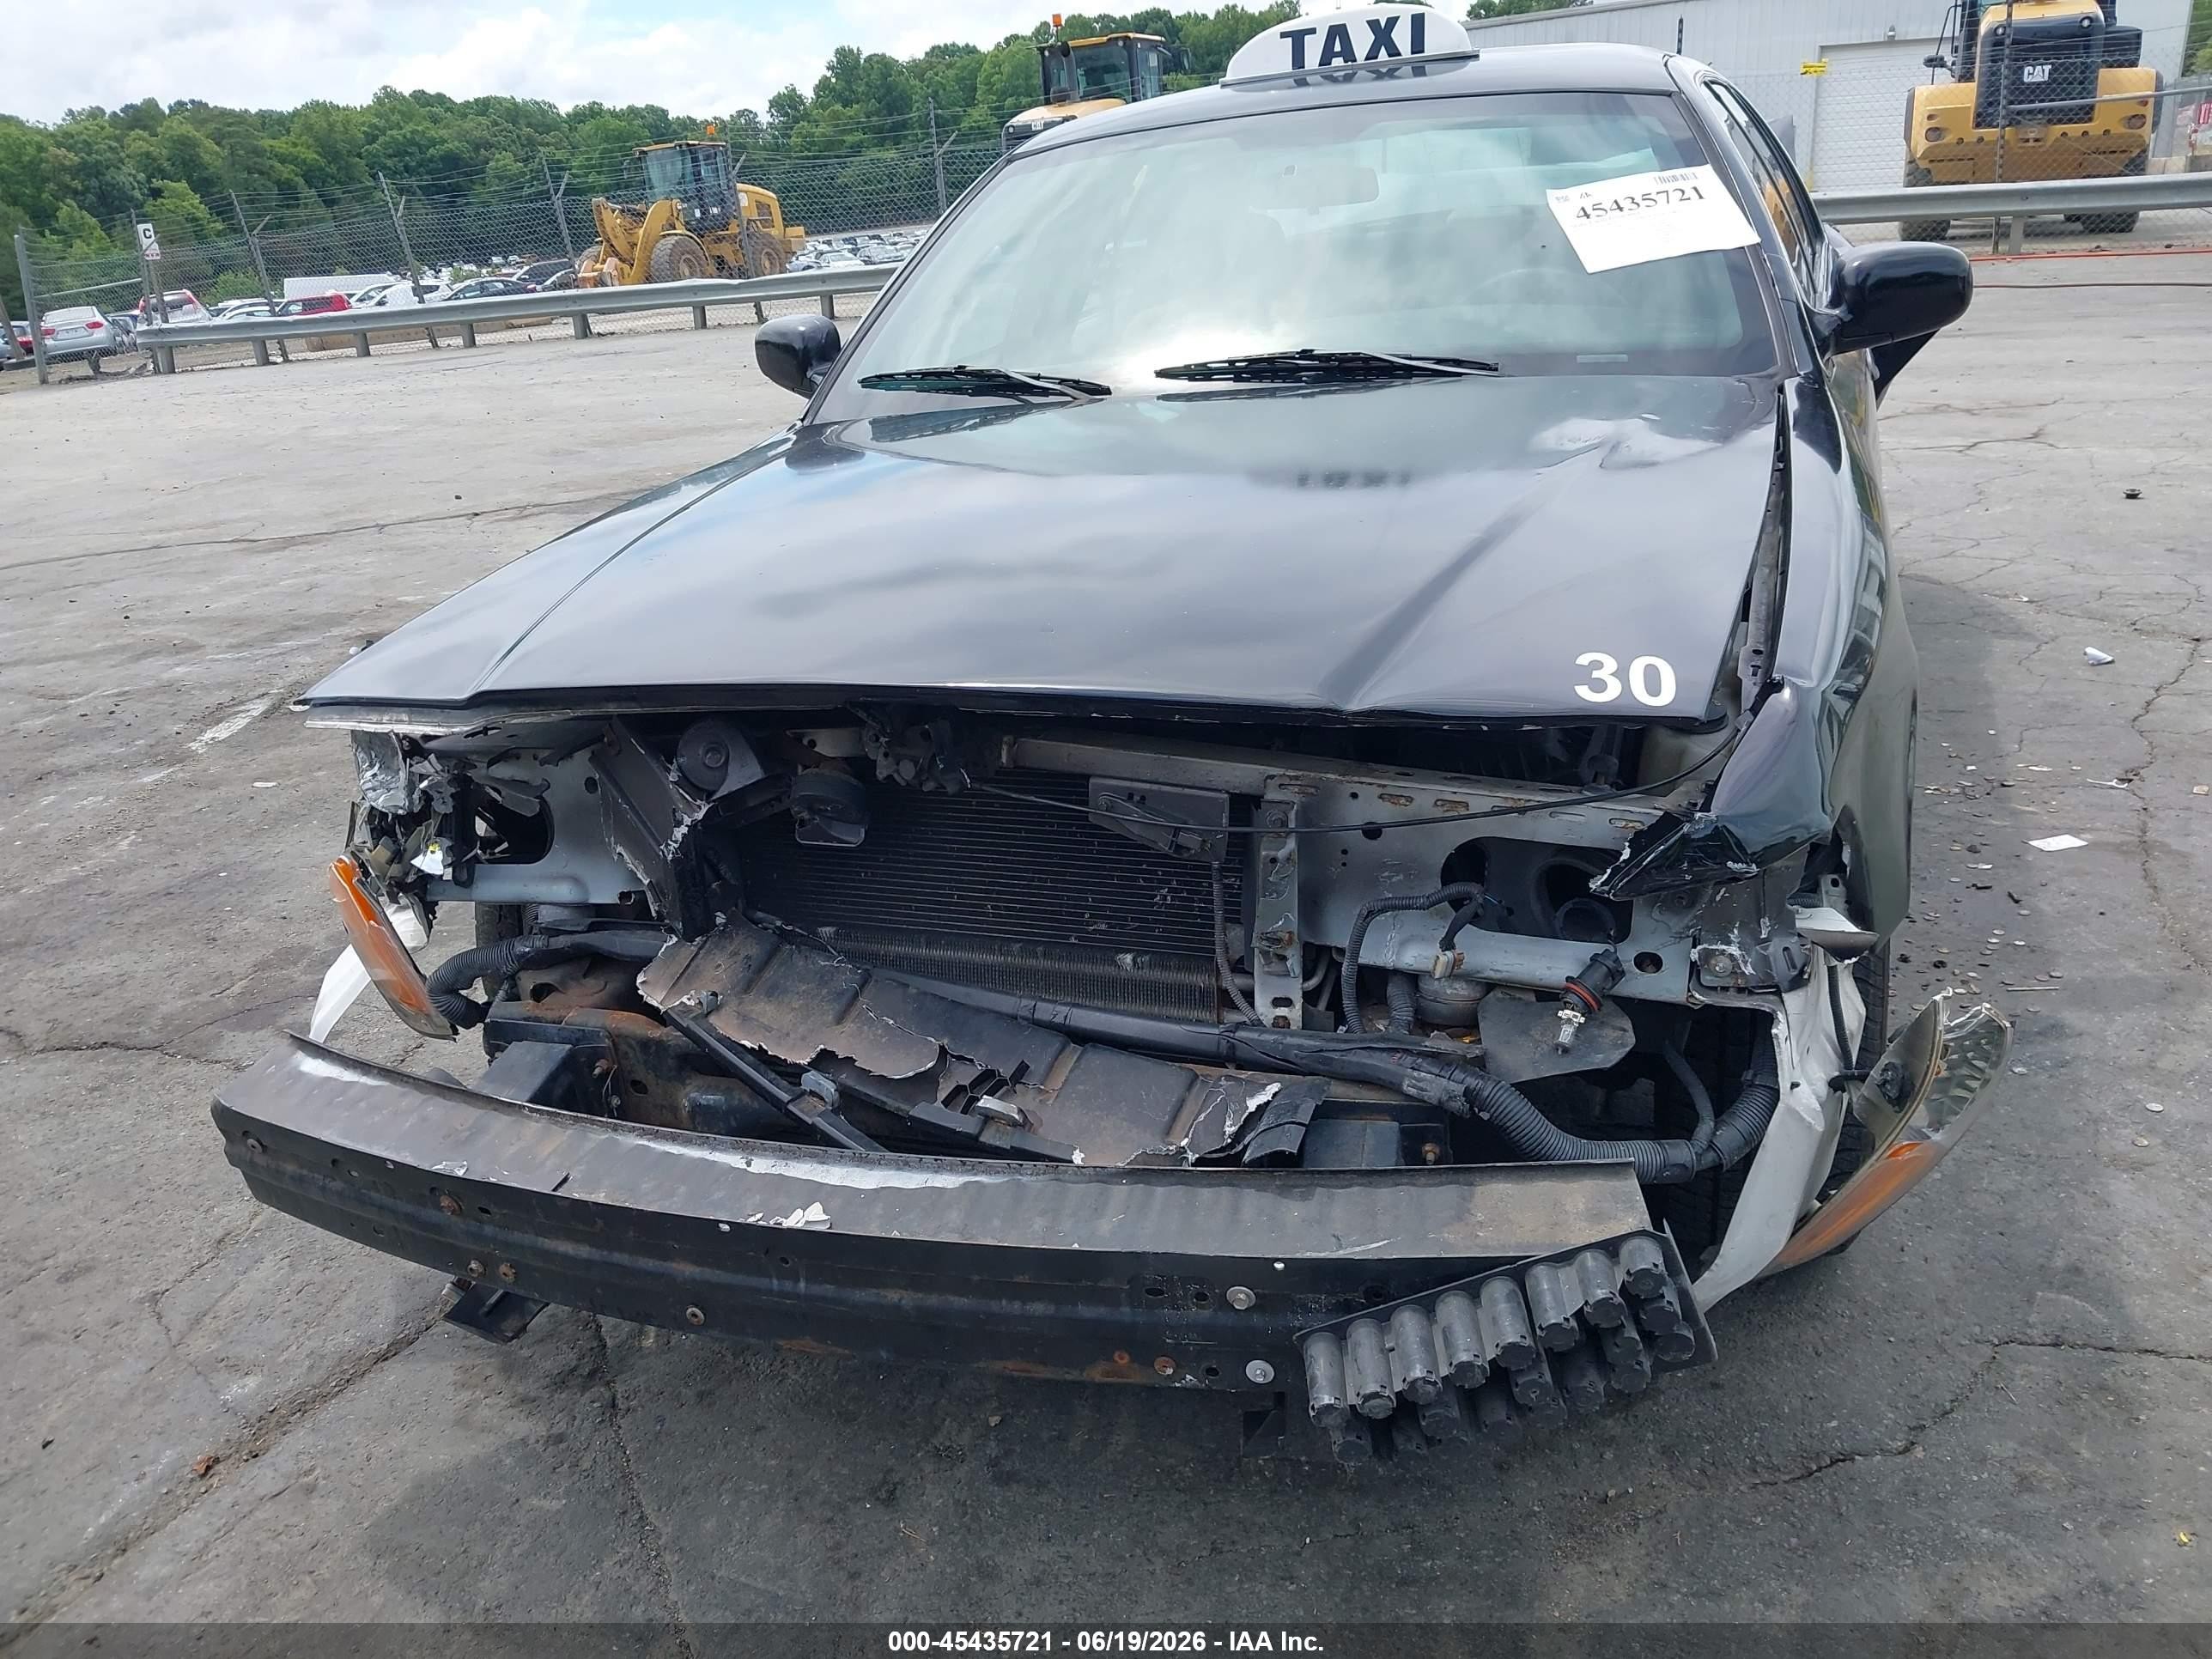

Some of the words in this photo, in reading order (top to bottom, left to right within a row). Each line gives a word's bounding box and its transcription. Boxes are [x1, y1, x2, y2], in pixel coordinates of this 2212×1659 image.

[1279, 12, 1425, 70] TAXI
[2023, 64, 2052, 82] CAT
[1576, 185, 1706, 220] 45435721
[143, 228, 153, 240] C
[1574, 652, 1677, 707] 30
